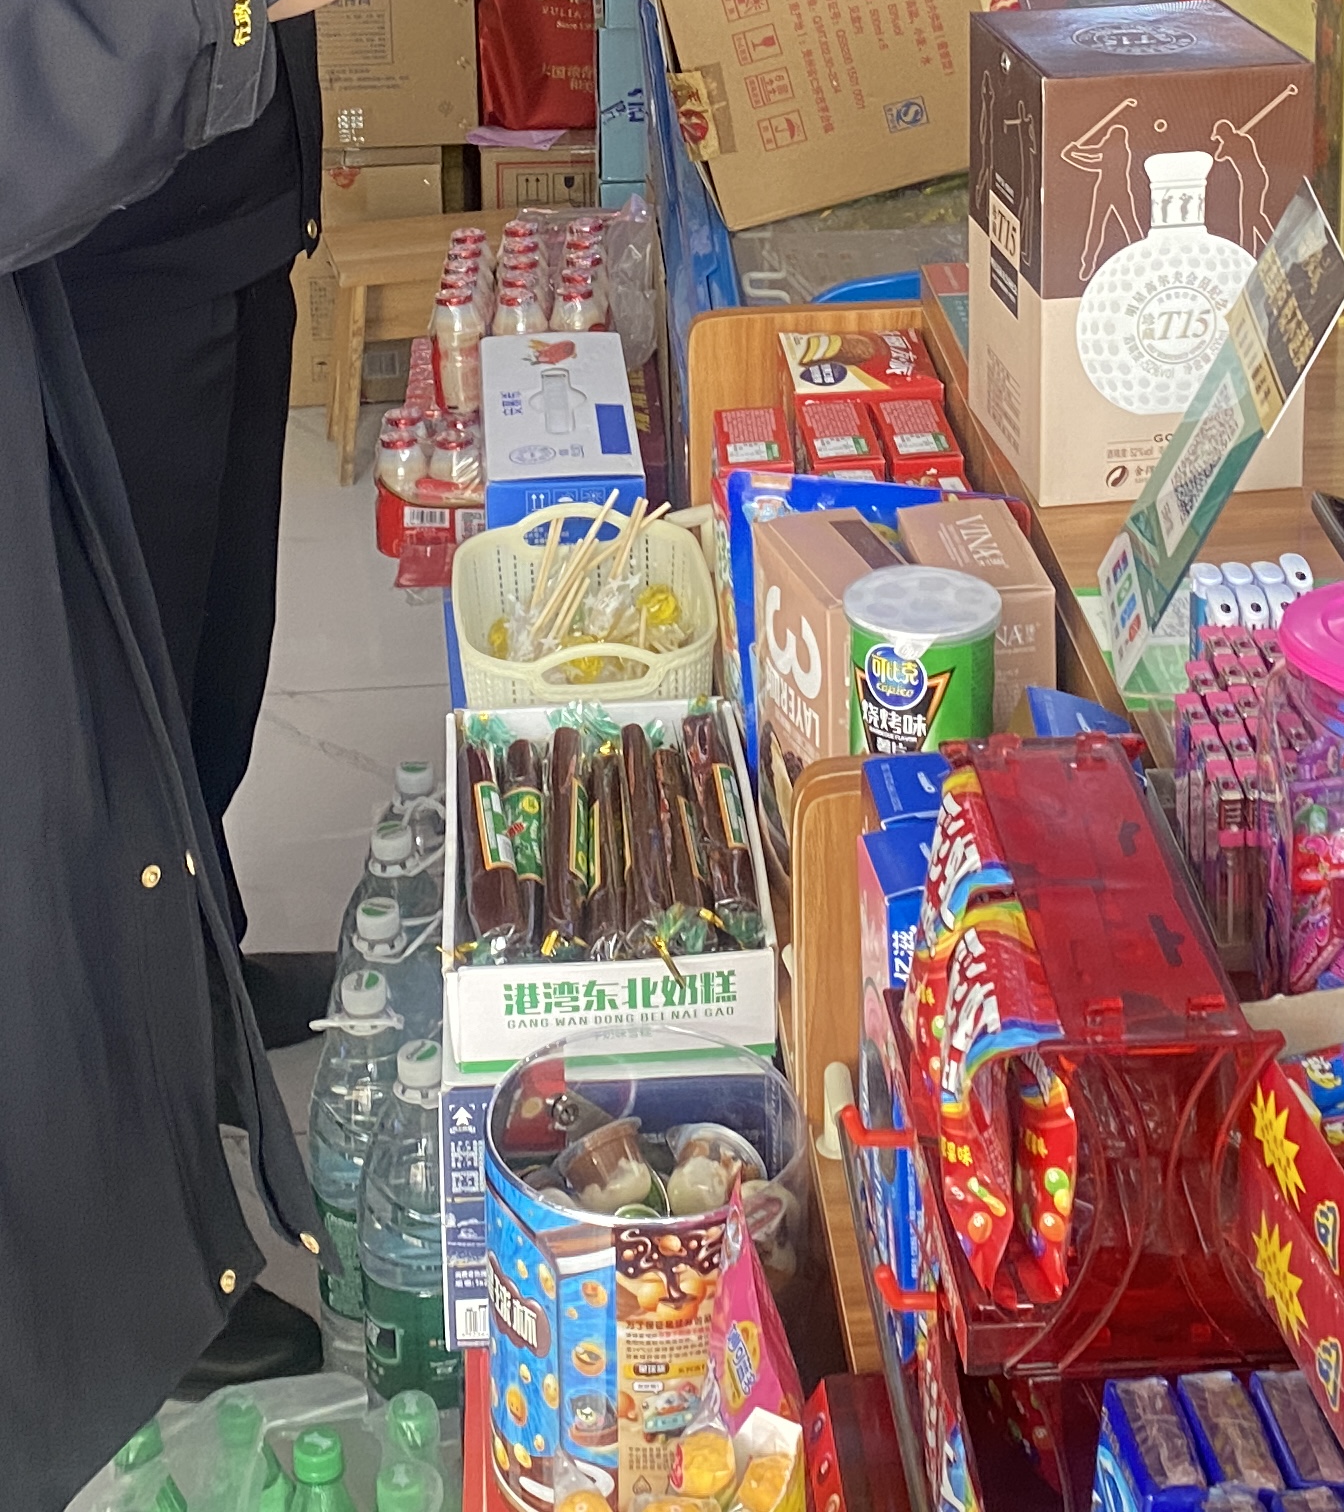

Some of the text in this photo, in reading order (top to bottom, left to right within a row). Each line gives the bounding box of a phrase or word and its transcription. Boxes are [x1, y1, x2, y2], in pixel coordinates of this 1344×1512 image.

[1157, 309, 1211, 341] T15
[871, 652, 919, 686] 可比克
[862, 699, 927, 737] 烧烤味
[503, 969, 737, 1016] 港湾东北奶糕
[507, 1006, 735, 1030] GANG WAN DONG BEI NAI GAO
